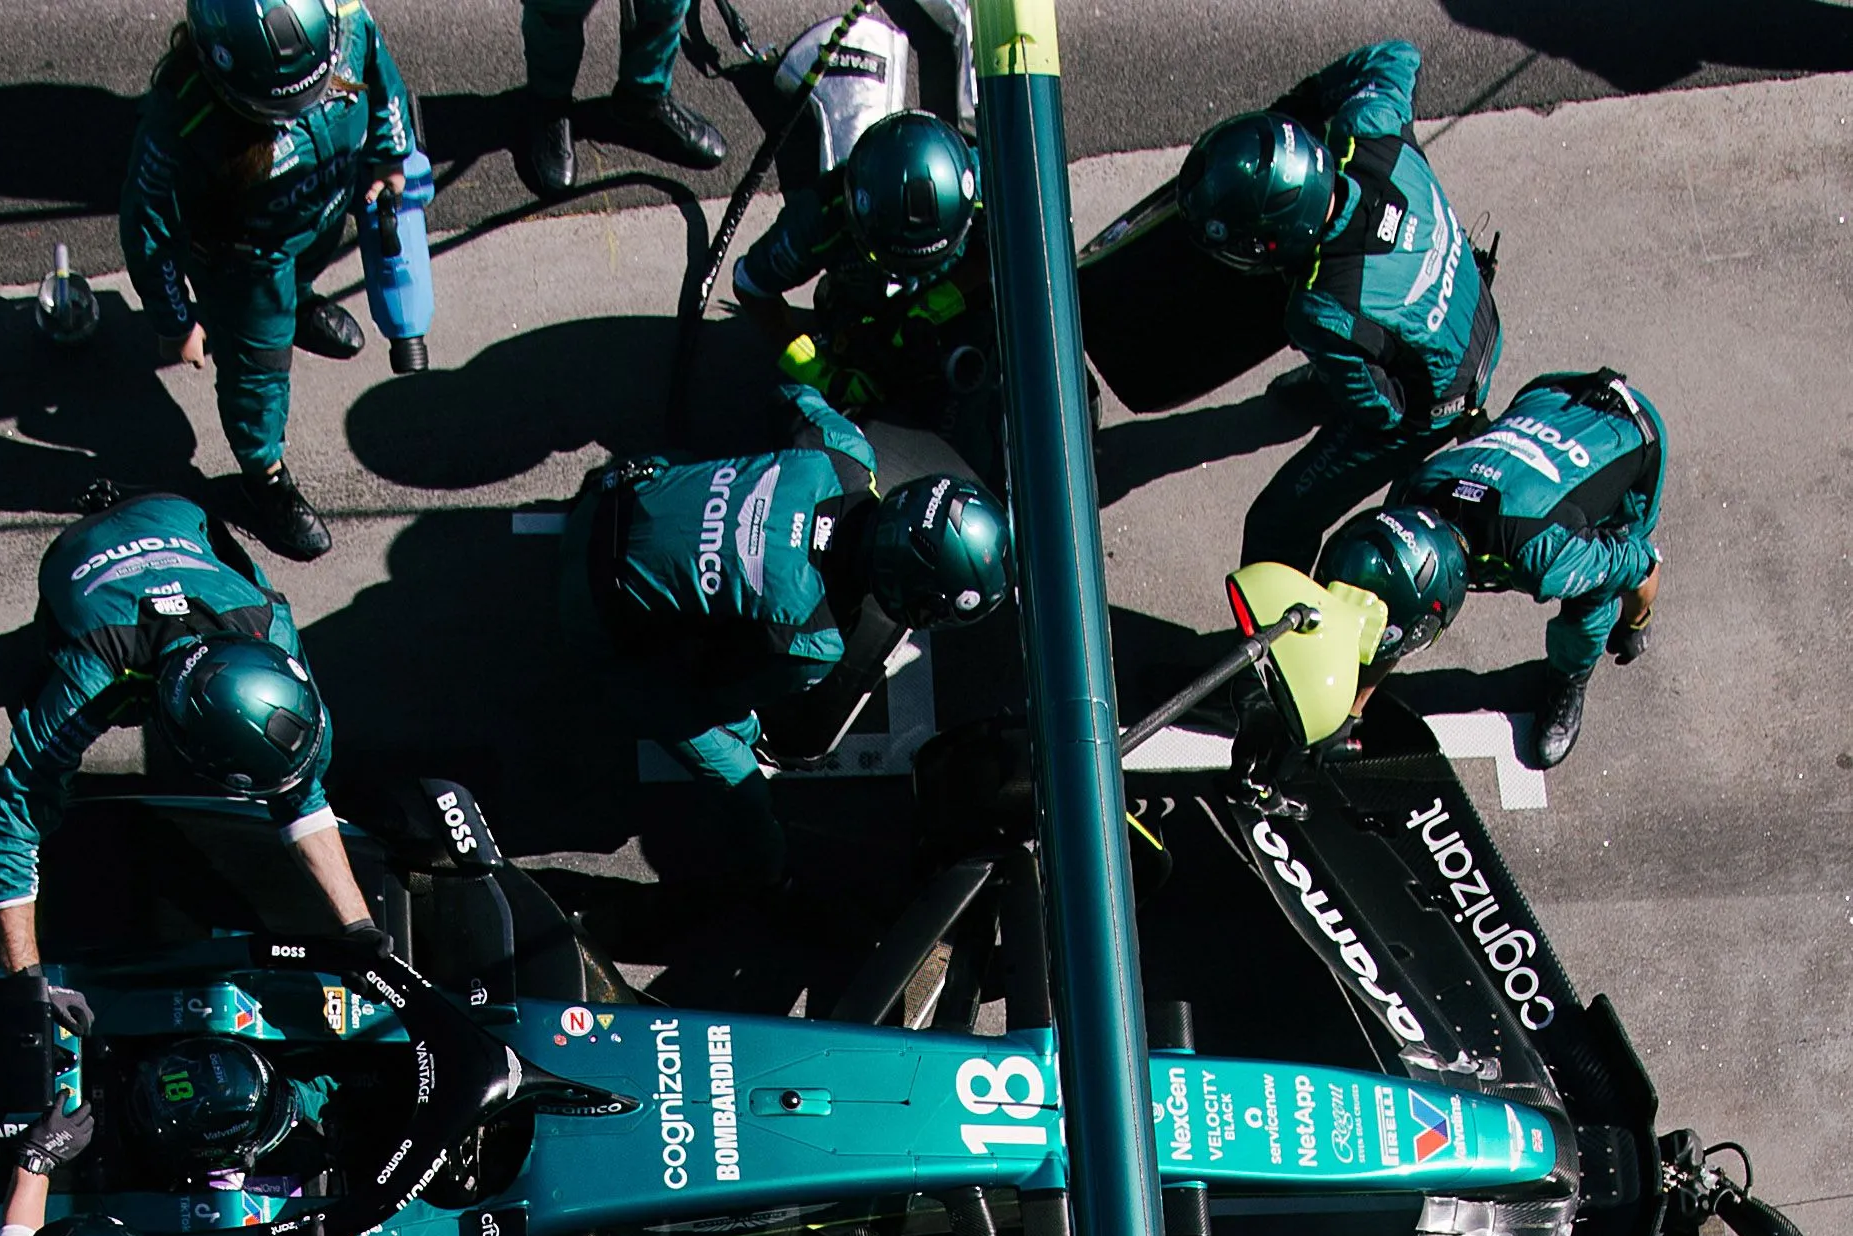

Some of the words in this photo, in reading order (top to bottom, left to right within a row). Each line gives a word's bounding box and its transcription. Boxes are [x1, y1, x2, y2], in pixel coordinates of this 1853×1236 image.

[1511, 416, 1593, 470] aram
[69, 536, 205, 582] aramco
[699, 465, 725, 596] aramco
[435, 791, 479, 855] BOSS
[270, 944, 307, 959] BOSS
[1251, 820, 1427, 1044] aramco
[1404, 797, 1555, 1032] cognizant
[364, 969, 407, 1010] aramco
[414, 1040, 431, 1104] VANTAGE
[647, 1018, 689, 1190] cognizant
[707, 1024, 741, 1182] BOMBARDIER
[955, 1054, 1049, 1156] 18
[1168, 1067, 1194, 1162] NexGen
[1201, 1070, 1224, 1162] VELOCITY
[1224, 1093, 1236, 1141] BLACK
[376, 1138, 413, 1186] aramco
[1263, 1073, 1283, 1165] servicenow
[1295, 1074, 1318, 1167] NetApp
[1375, 1085, 1401, 1167] PIRELLI
